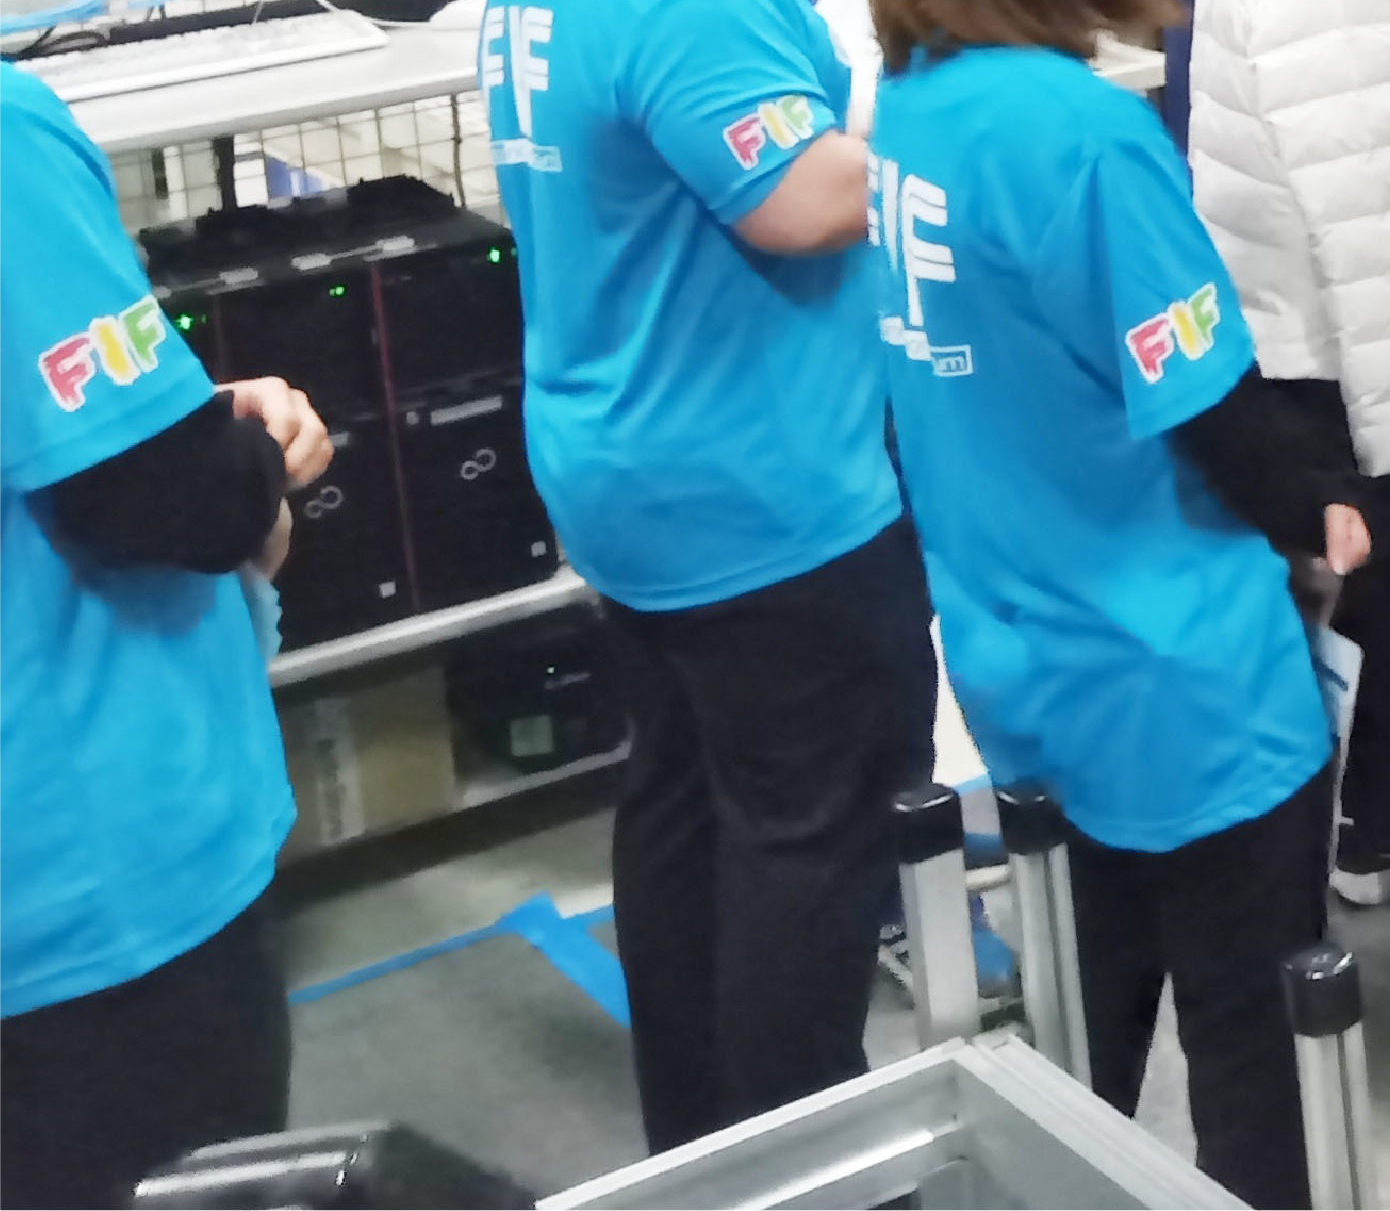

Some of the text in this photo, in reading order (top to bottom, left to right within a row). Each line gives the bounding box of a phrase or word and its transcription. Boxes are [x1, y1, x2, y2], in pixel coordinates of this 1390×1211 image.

[722, 94, 814, 170] FIF
[38, 293, 166, 412] FIF
[1125, 282, 1220, 383] FIF
